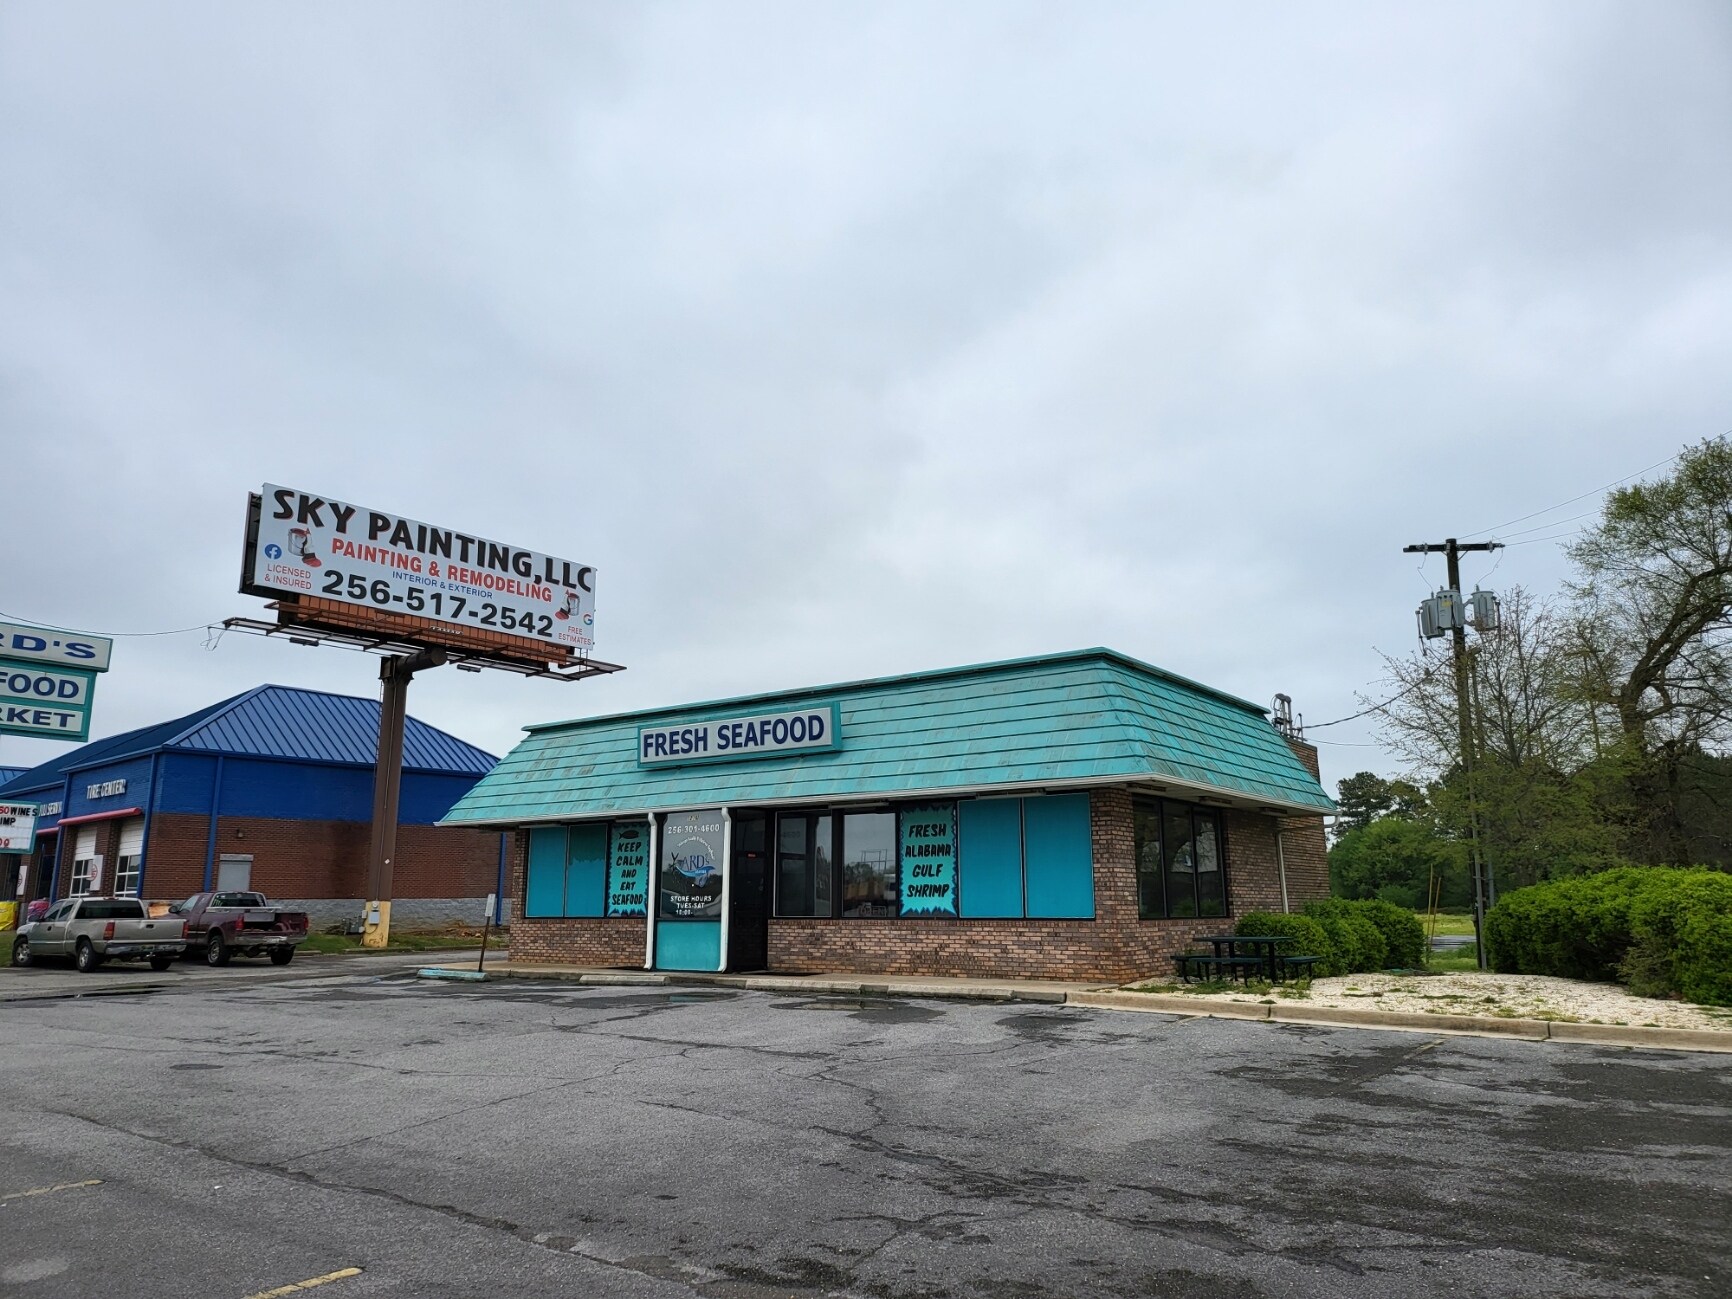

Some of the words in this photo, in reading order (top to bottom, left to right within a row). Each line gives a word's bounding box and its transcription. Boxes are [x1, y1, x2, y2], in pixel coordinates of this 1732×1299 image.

[273, 489, 356, 534] SKY
[369, 512, 592, 593] PAINTING,LLC
[267, 563, 311, 579] LICENSED
[331, 537, 422, 574] PAINTING
[428, 560, 440, 578] &
[447, 564, 552, 603] REMODELING
[264, 573, 271, 582] &
[273, 575, 312, 590] INSURED
[392, 570, 437, 588] INTERIOR
[448, 583, 493, 599] EXTERIOR
[321, 569, 553, 638] 256-517-2542
[567, 625, 583, 636] FREE
[0, 632, 96, 659] D'S
[558, 633, 592, 646] ESTIMATES
[0, 707, 76, 728] KET
[643, 727, 708, 758] FRESH
[717, 715, 824, 750] SEAFOOD
[87, 784, 100, 800] TIRE
[100, 779, 127, 798] CENTER
[908, 823, 947, 839] FRESH
[617, 841, 641, 852] KEEP
[905, 843, 951, 858] ALABAMA
[616, 856, 643, 866] CALM
[621, 869, 637, 878] AND
[912, 863, 943, 878] GULF
[620, 881, 636, 891] EAT
[907, 883, 950, 898] SHRIMP
[612, 893, 643, 906] SEAFOOD
